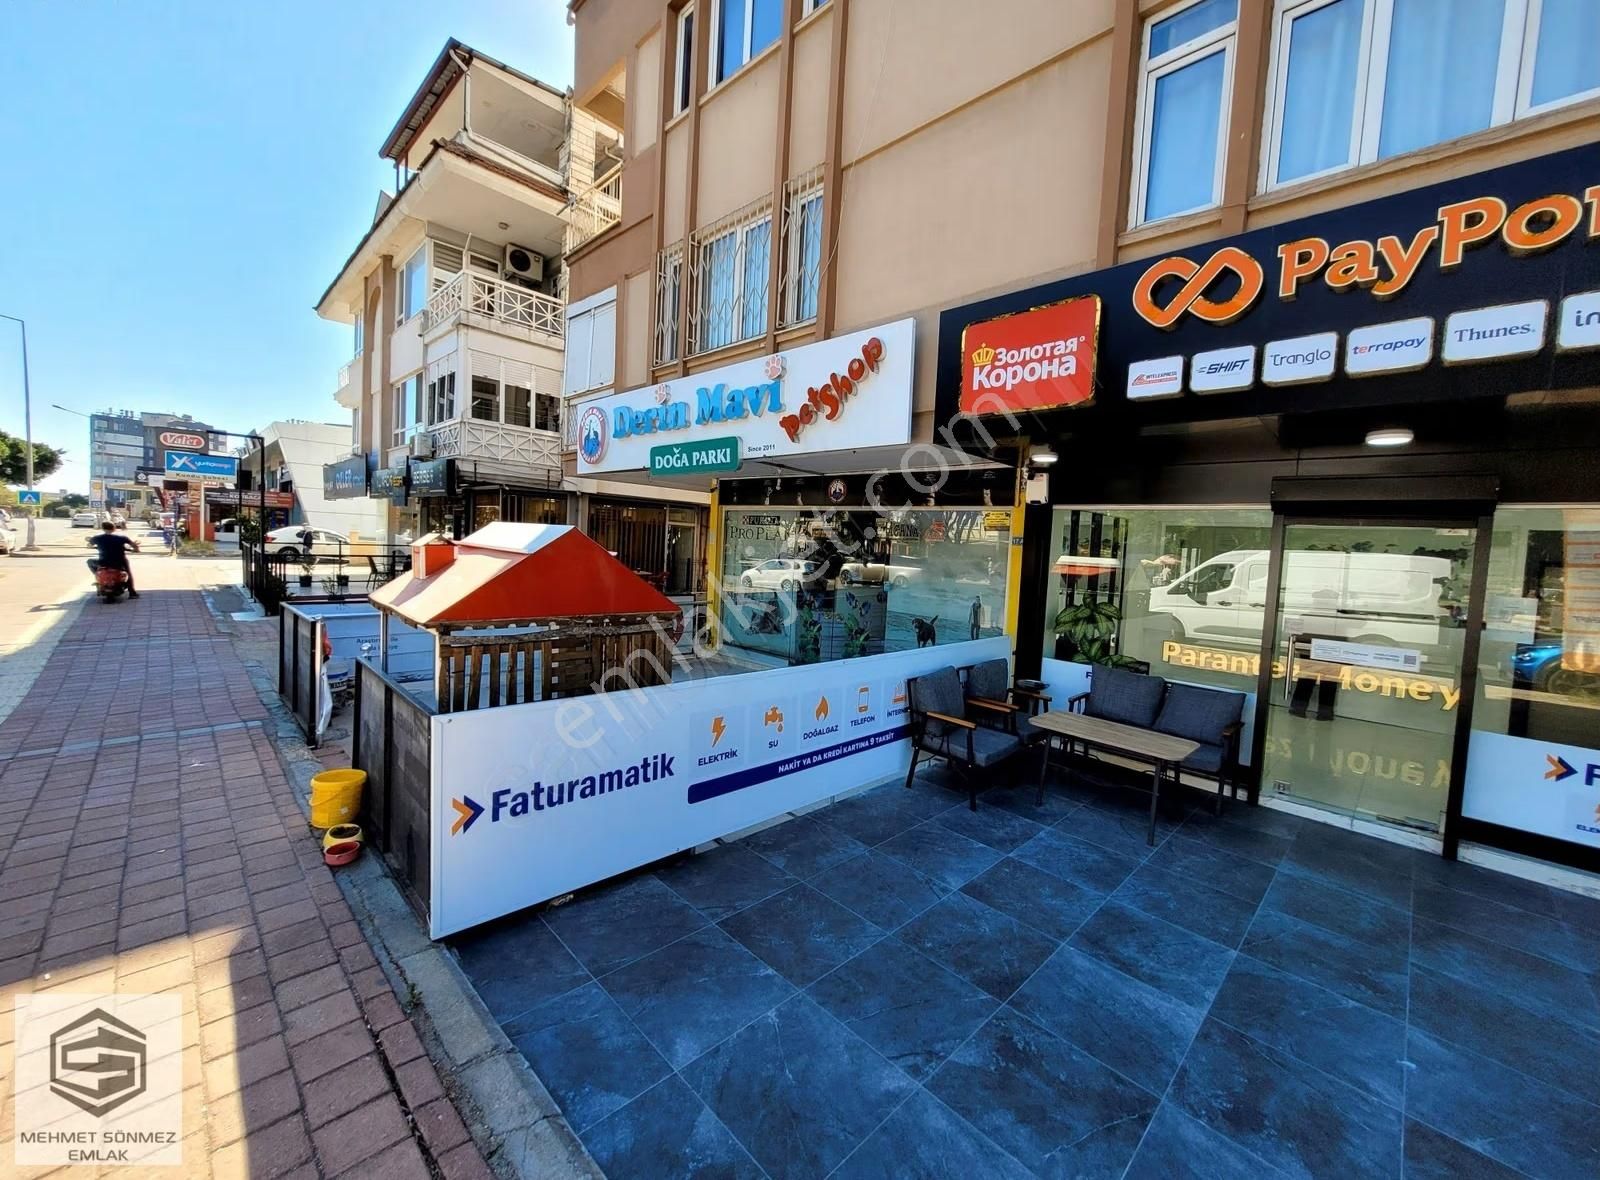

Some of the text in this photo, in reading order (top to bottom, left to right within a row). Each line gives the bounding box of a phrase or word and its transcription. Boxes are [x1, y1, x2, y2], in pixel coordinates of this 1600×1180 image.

[1352, 337, 1426, 355] terrapay
[972, 355, 1077, 391] Корона
[1206, 359, 1250, 375] SHIFT
[613, 400, 688, 438] Derin
[696, 376, 783, 426] Mavi
[655, 447, 731, 469] DOĞA PARKI
[850, 715, 876, 727] TELEFON
[803, 724, 839, 740] DOĞALGAZ
[768, 739, 779, 749] SU
[778, 732, 894, 773] NAKİT YA DA KREDİ KARTINA 9 TAKSİT
[698, 748, 738, 767] ELEKTRİK
[491, 753, 676, 823] Faturamatik
